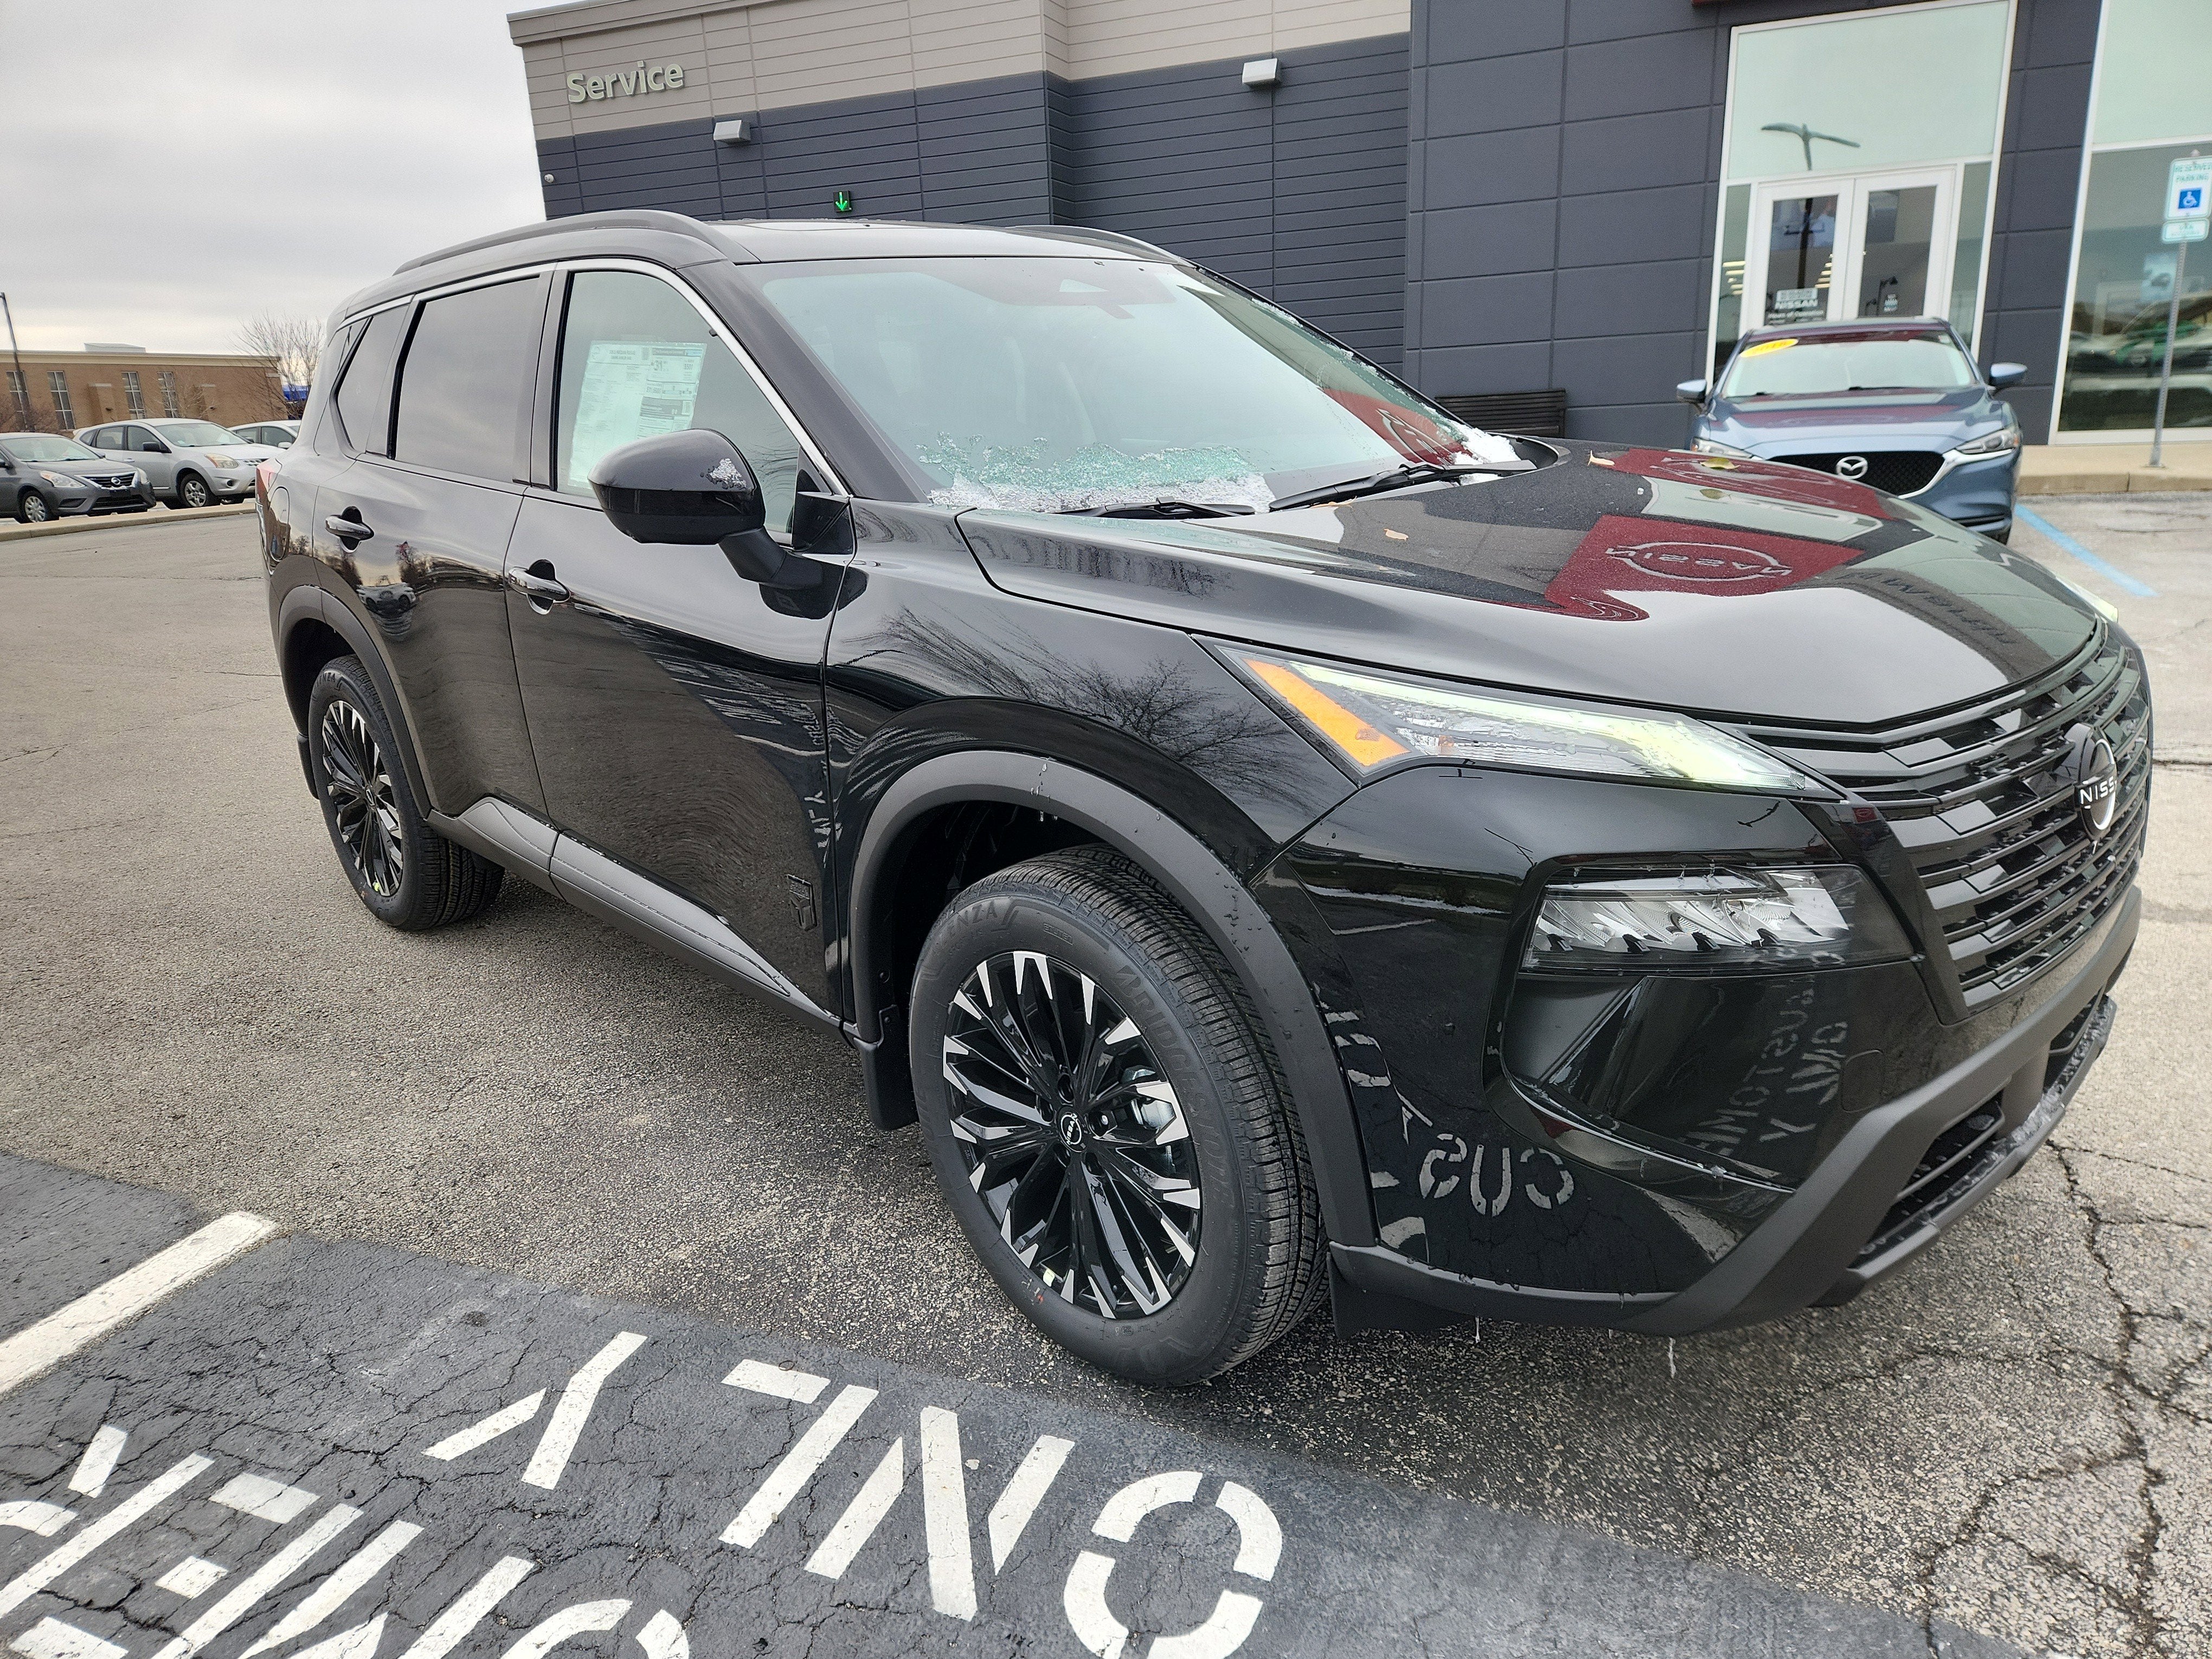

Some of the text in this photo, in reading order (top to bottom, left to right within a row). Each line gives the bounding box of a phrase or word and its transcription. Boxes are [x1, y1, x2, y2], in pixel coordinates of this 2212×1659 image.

[566, 60, 685, 104] Service
[1775, 299, 1818, 310] NISSAN
[2080, 775, 2117, 805] NISS
[1066, 1113, 1078, 1146] NISSAN
[424, 1332, 1284, 1659] ONLY
